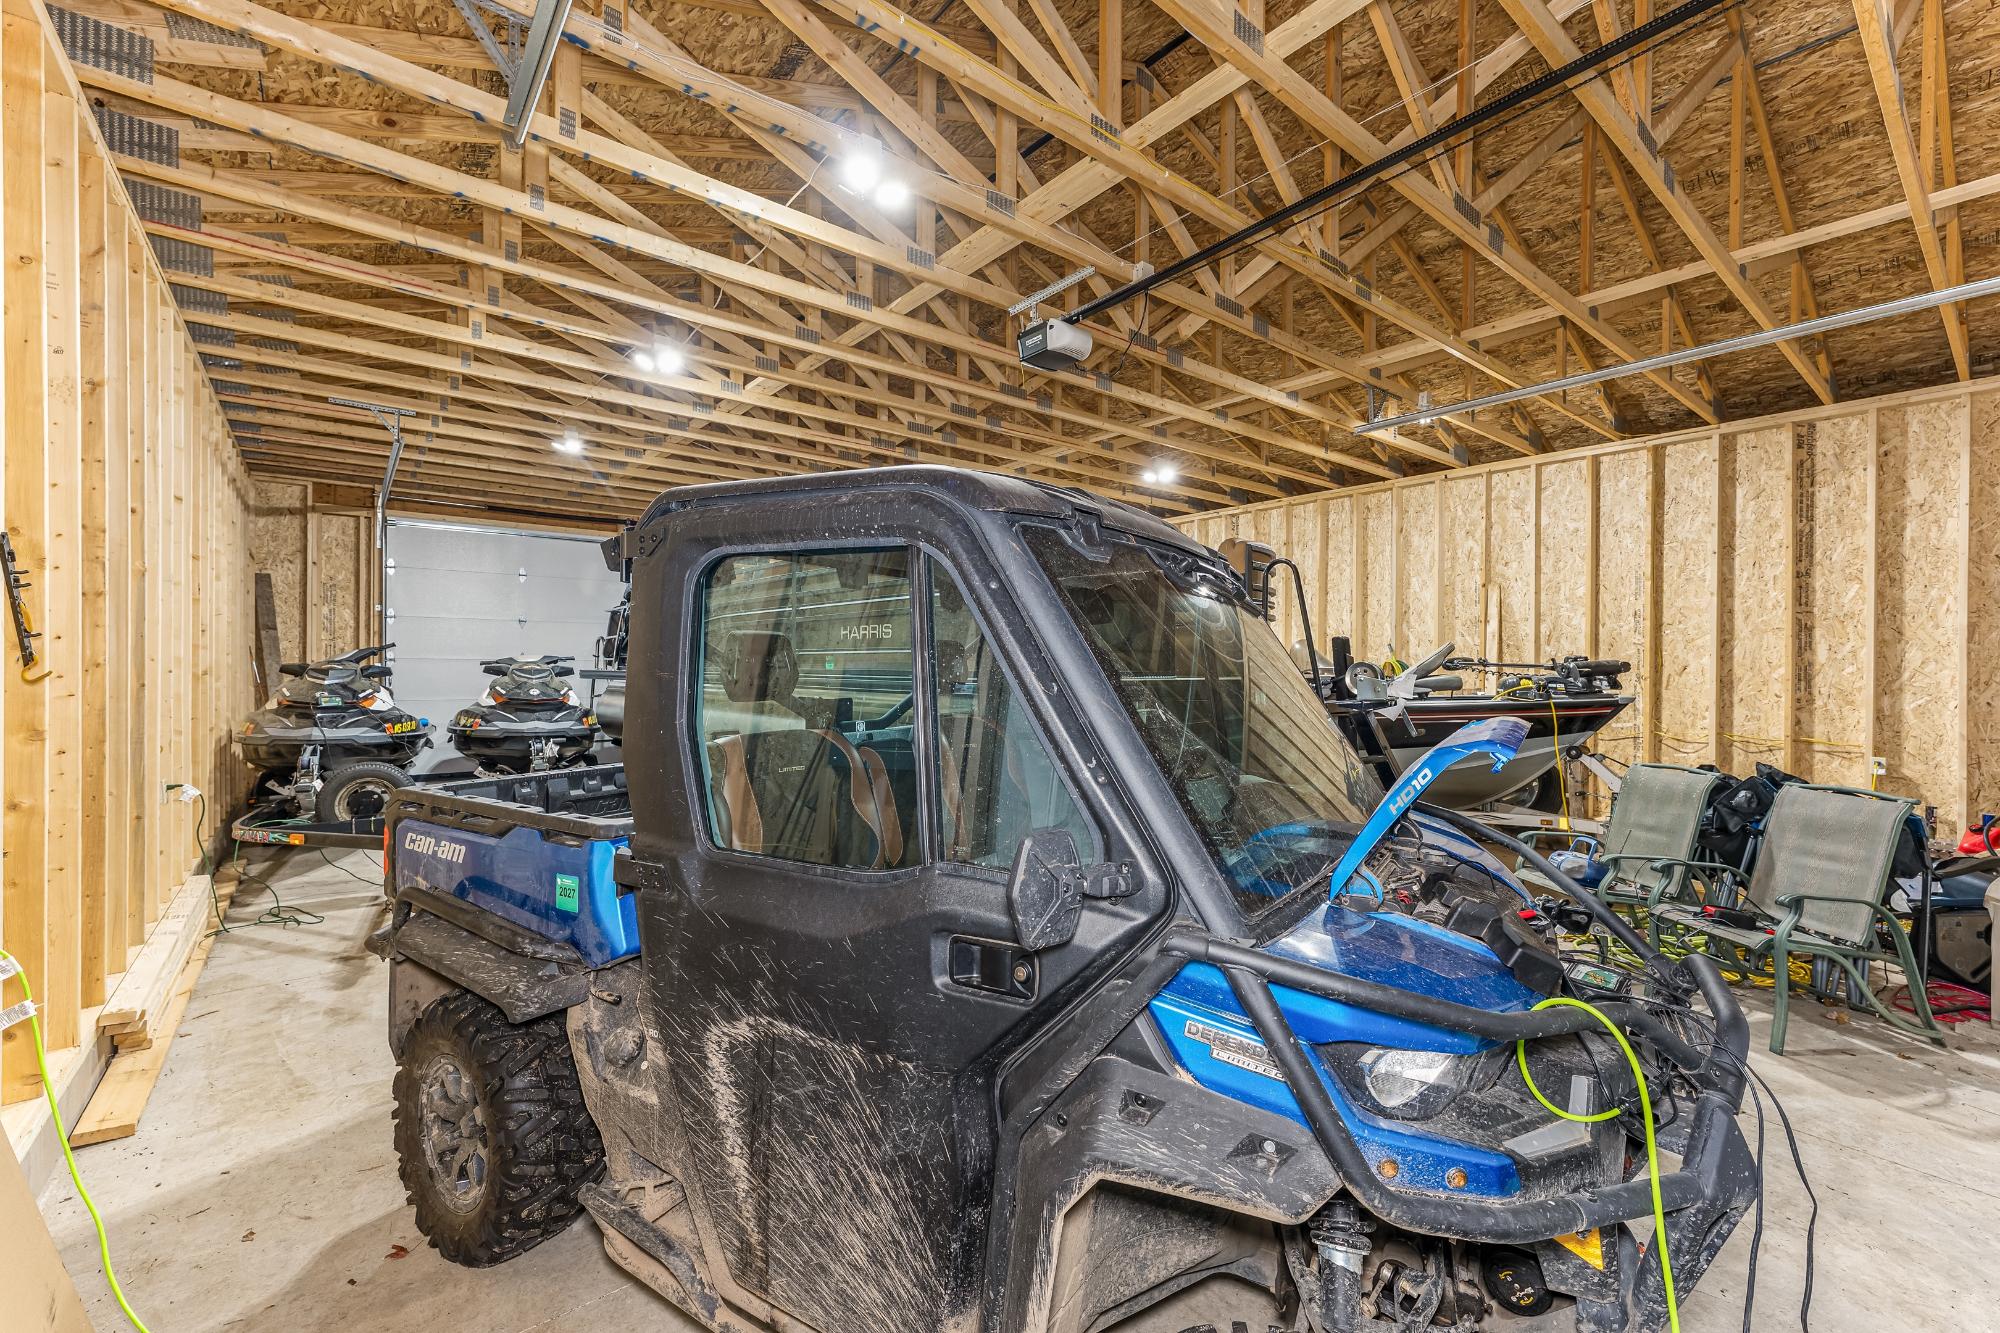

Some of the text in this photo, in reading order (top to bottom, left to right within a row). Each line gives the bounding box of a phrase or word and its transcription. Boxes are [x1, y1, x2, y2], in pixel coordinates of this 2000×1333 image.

[840, 623, 892, 640] HARRIS
[1389, 767, 1433, 816] HD10
[404, 832, 466, 864] can-am
[559, 886, 576, 899] 2027
[1186, 1021, 1269, 1061] DEFEND
